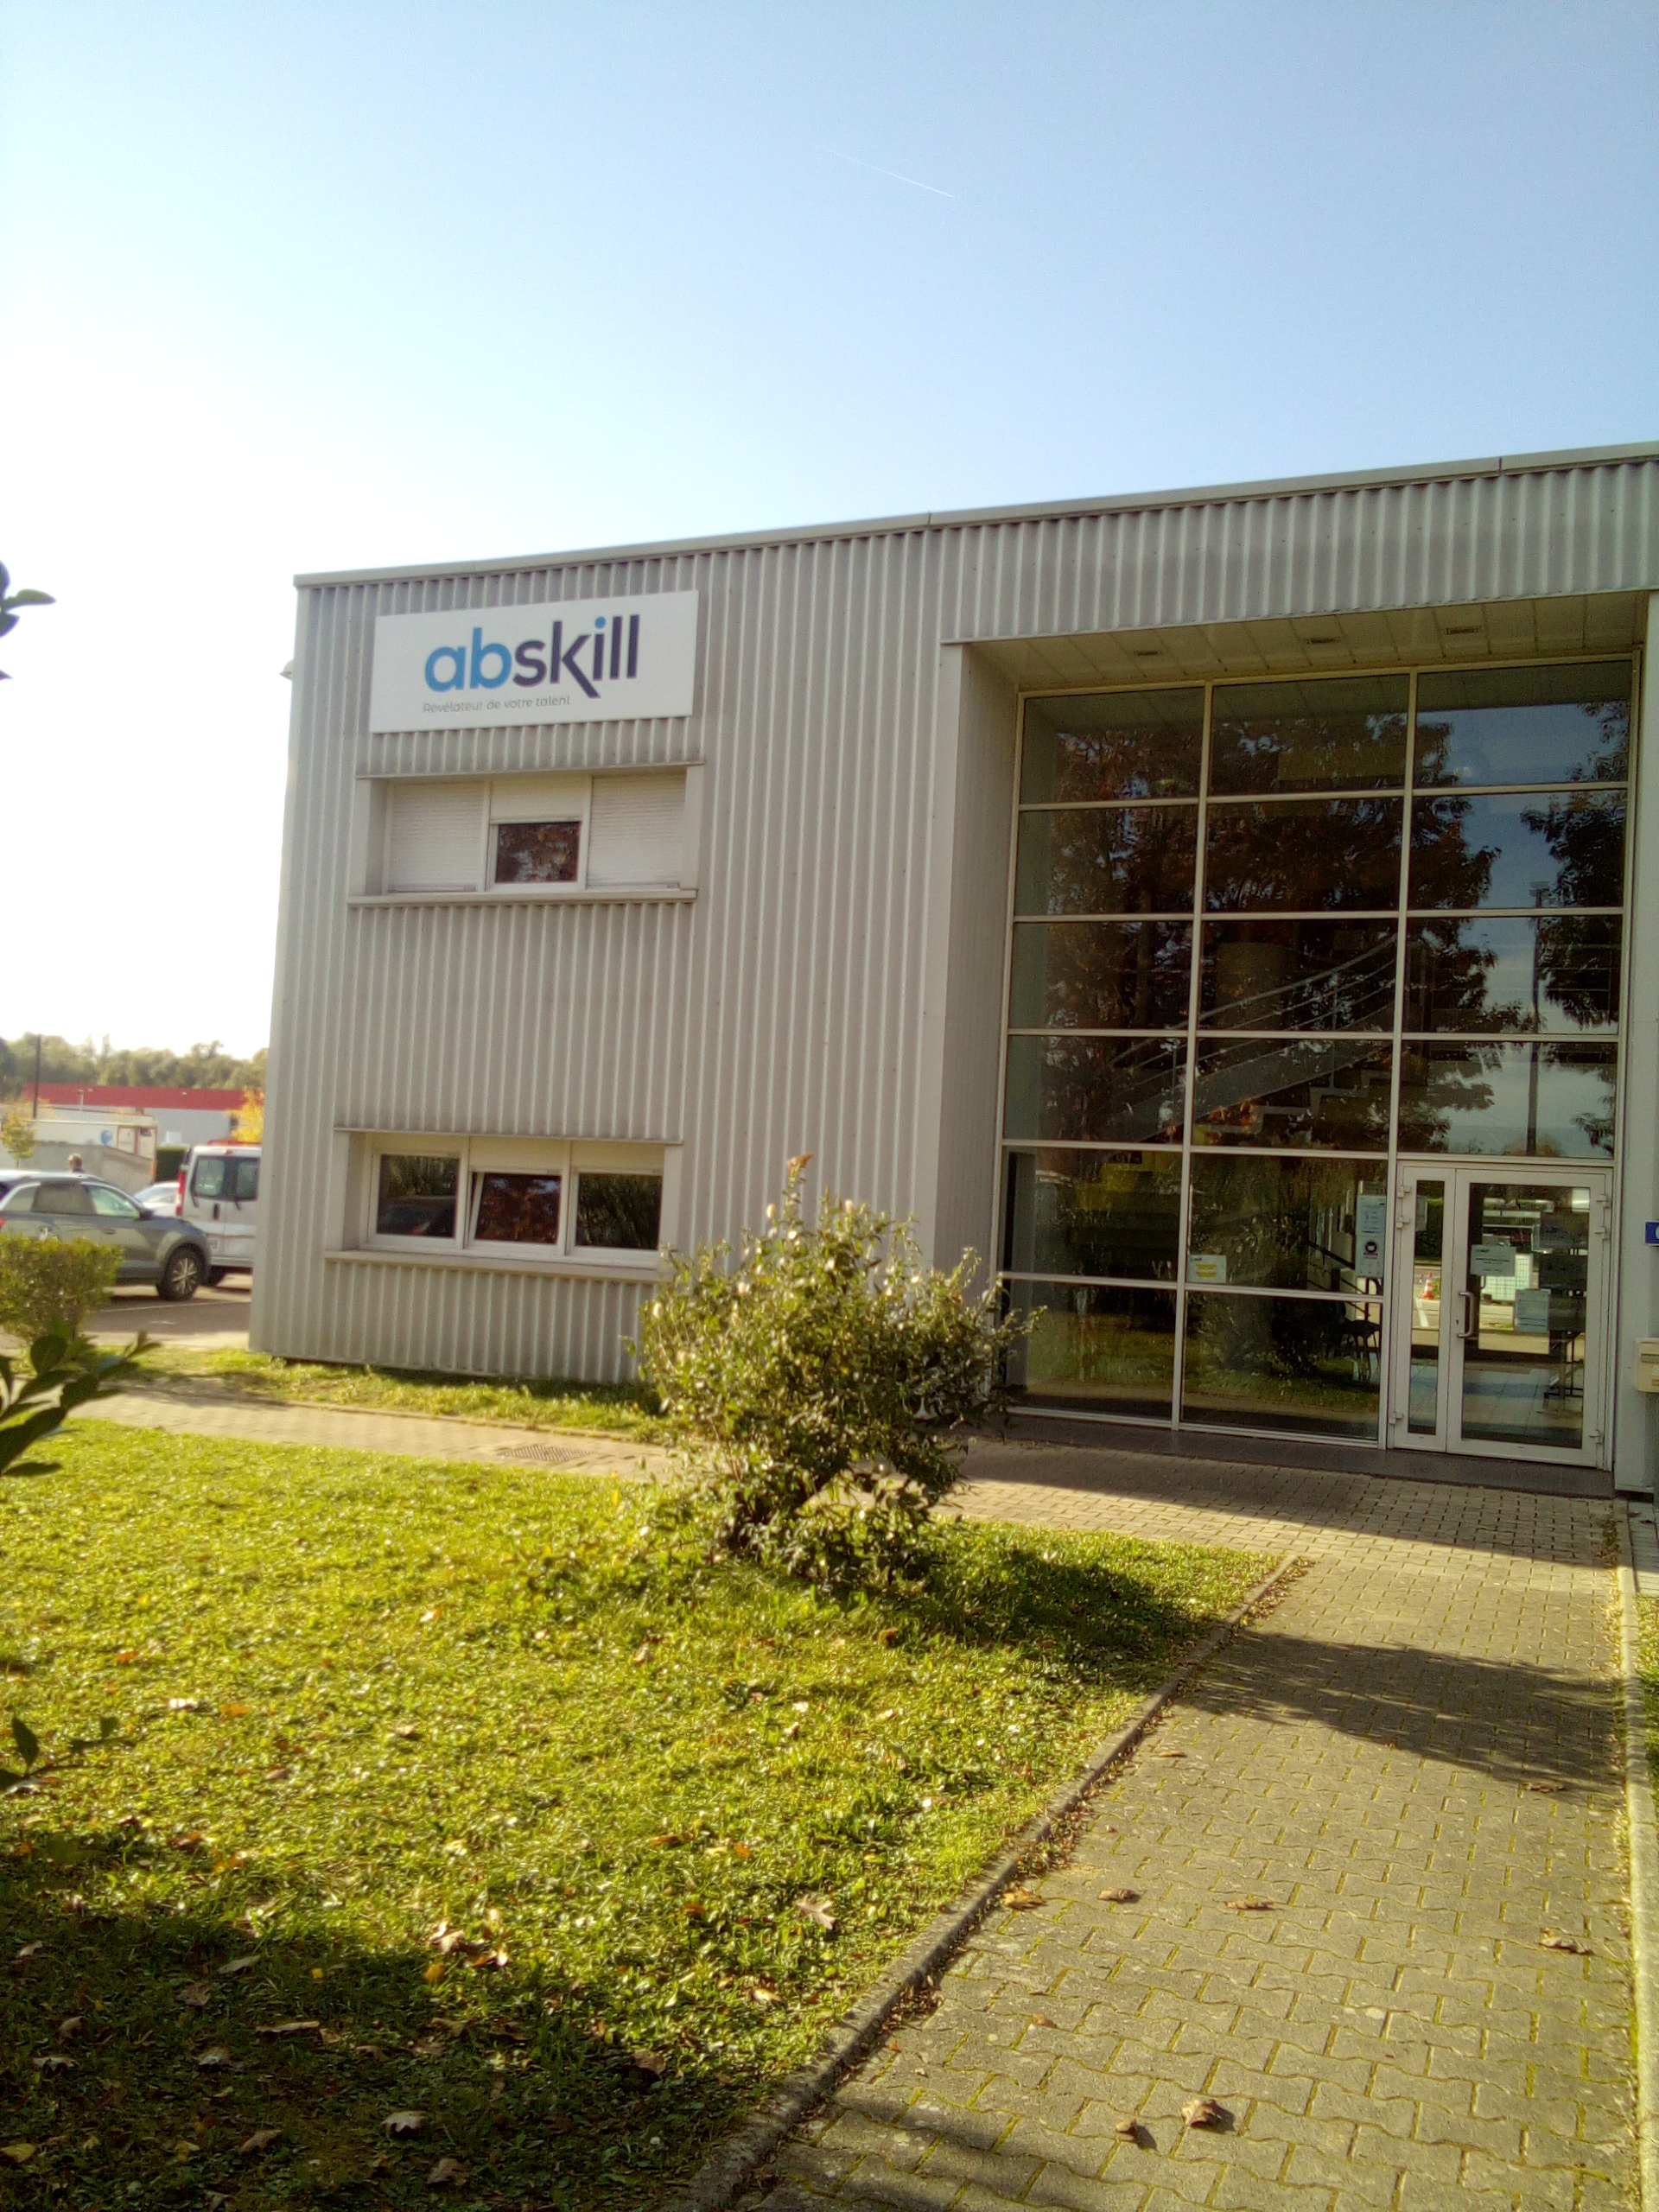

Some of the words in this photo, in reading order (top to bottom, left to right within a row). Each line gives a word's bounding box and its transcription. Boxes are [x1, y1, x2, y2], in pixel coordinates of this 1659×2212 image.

[424, 614, 640, 699] abskill
[486, 699, 501, 710] de
[504, 698, 533, 709] votre
[536, 695, 571, 707] talent
